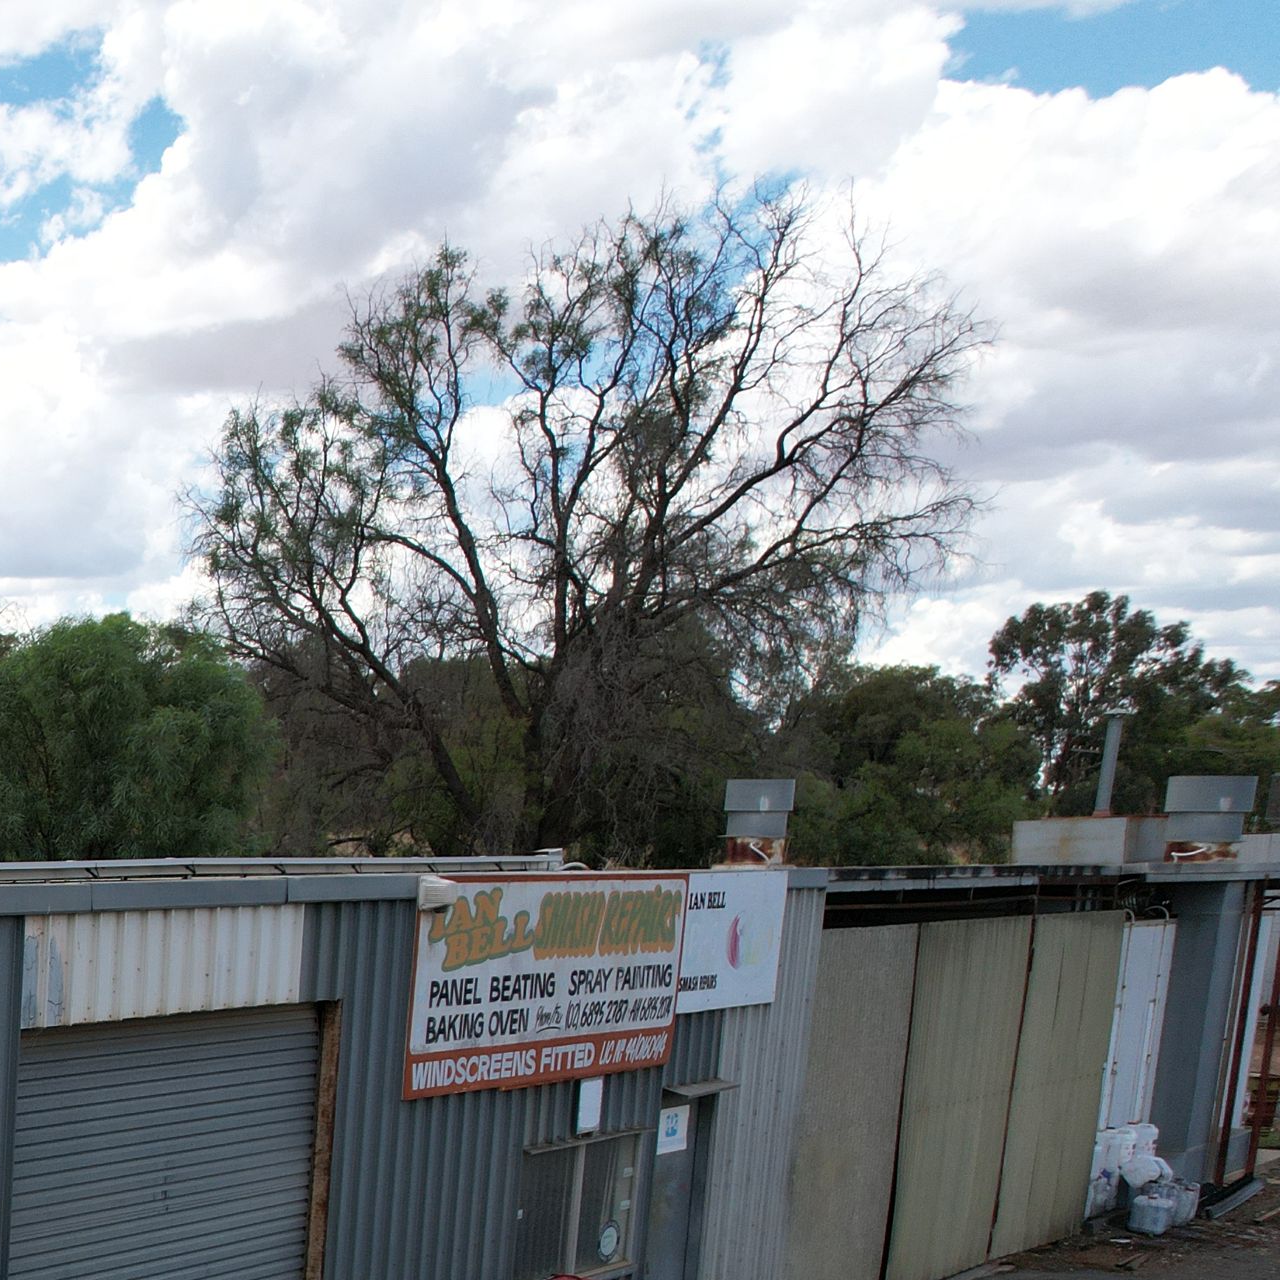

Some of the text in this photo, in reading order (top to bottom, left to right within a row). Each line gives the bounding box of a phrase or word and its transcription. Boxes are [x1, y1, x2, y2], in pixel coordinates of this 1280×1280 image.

[534, 884, 683, 960] SMASH REPAIRS
[689, 891, 726, 910] IAN BELL
[441, 911, 535, 973] BELL
[428, 964, 673, 1008] PANEL BEATING SPRAY PAINTING
[679, 975, 699, 992] SMASH
[425, 1011, 485, 1044] BAKING
[488, 1008, 530, 1037] OVEN
[565, 1000, 580, 1031] (02)
[580, 1001, 605, 1028] 6895
[605, 999, 629, 1024] 2787
[412, 1048, 537, 1091] WINDSCREENS
[540, 1042, 596, 1073] FITTED
